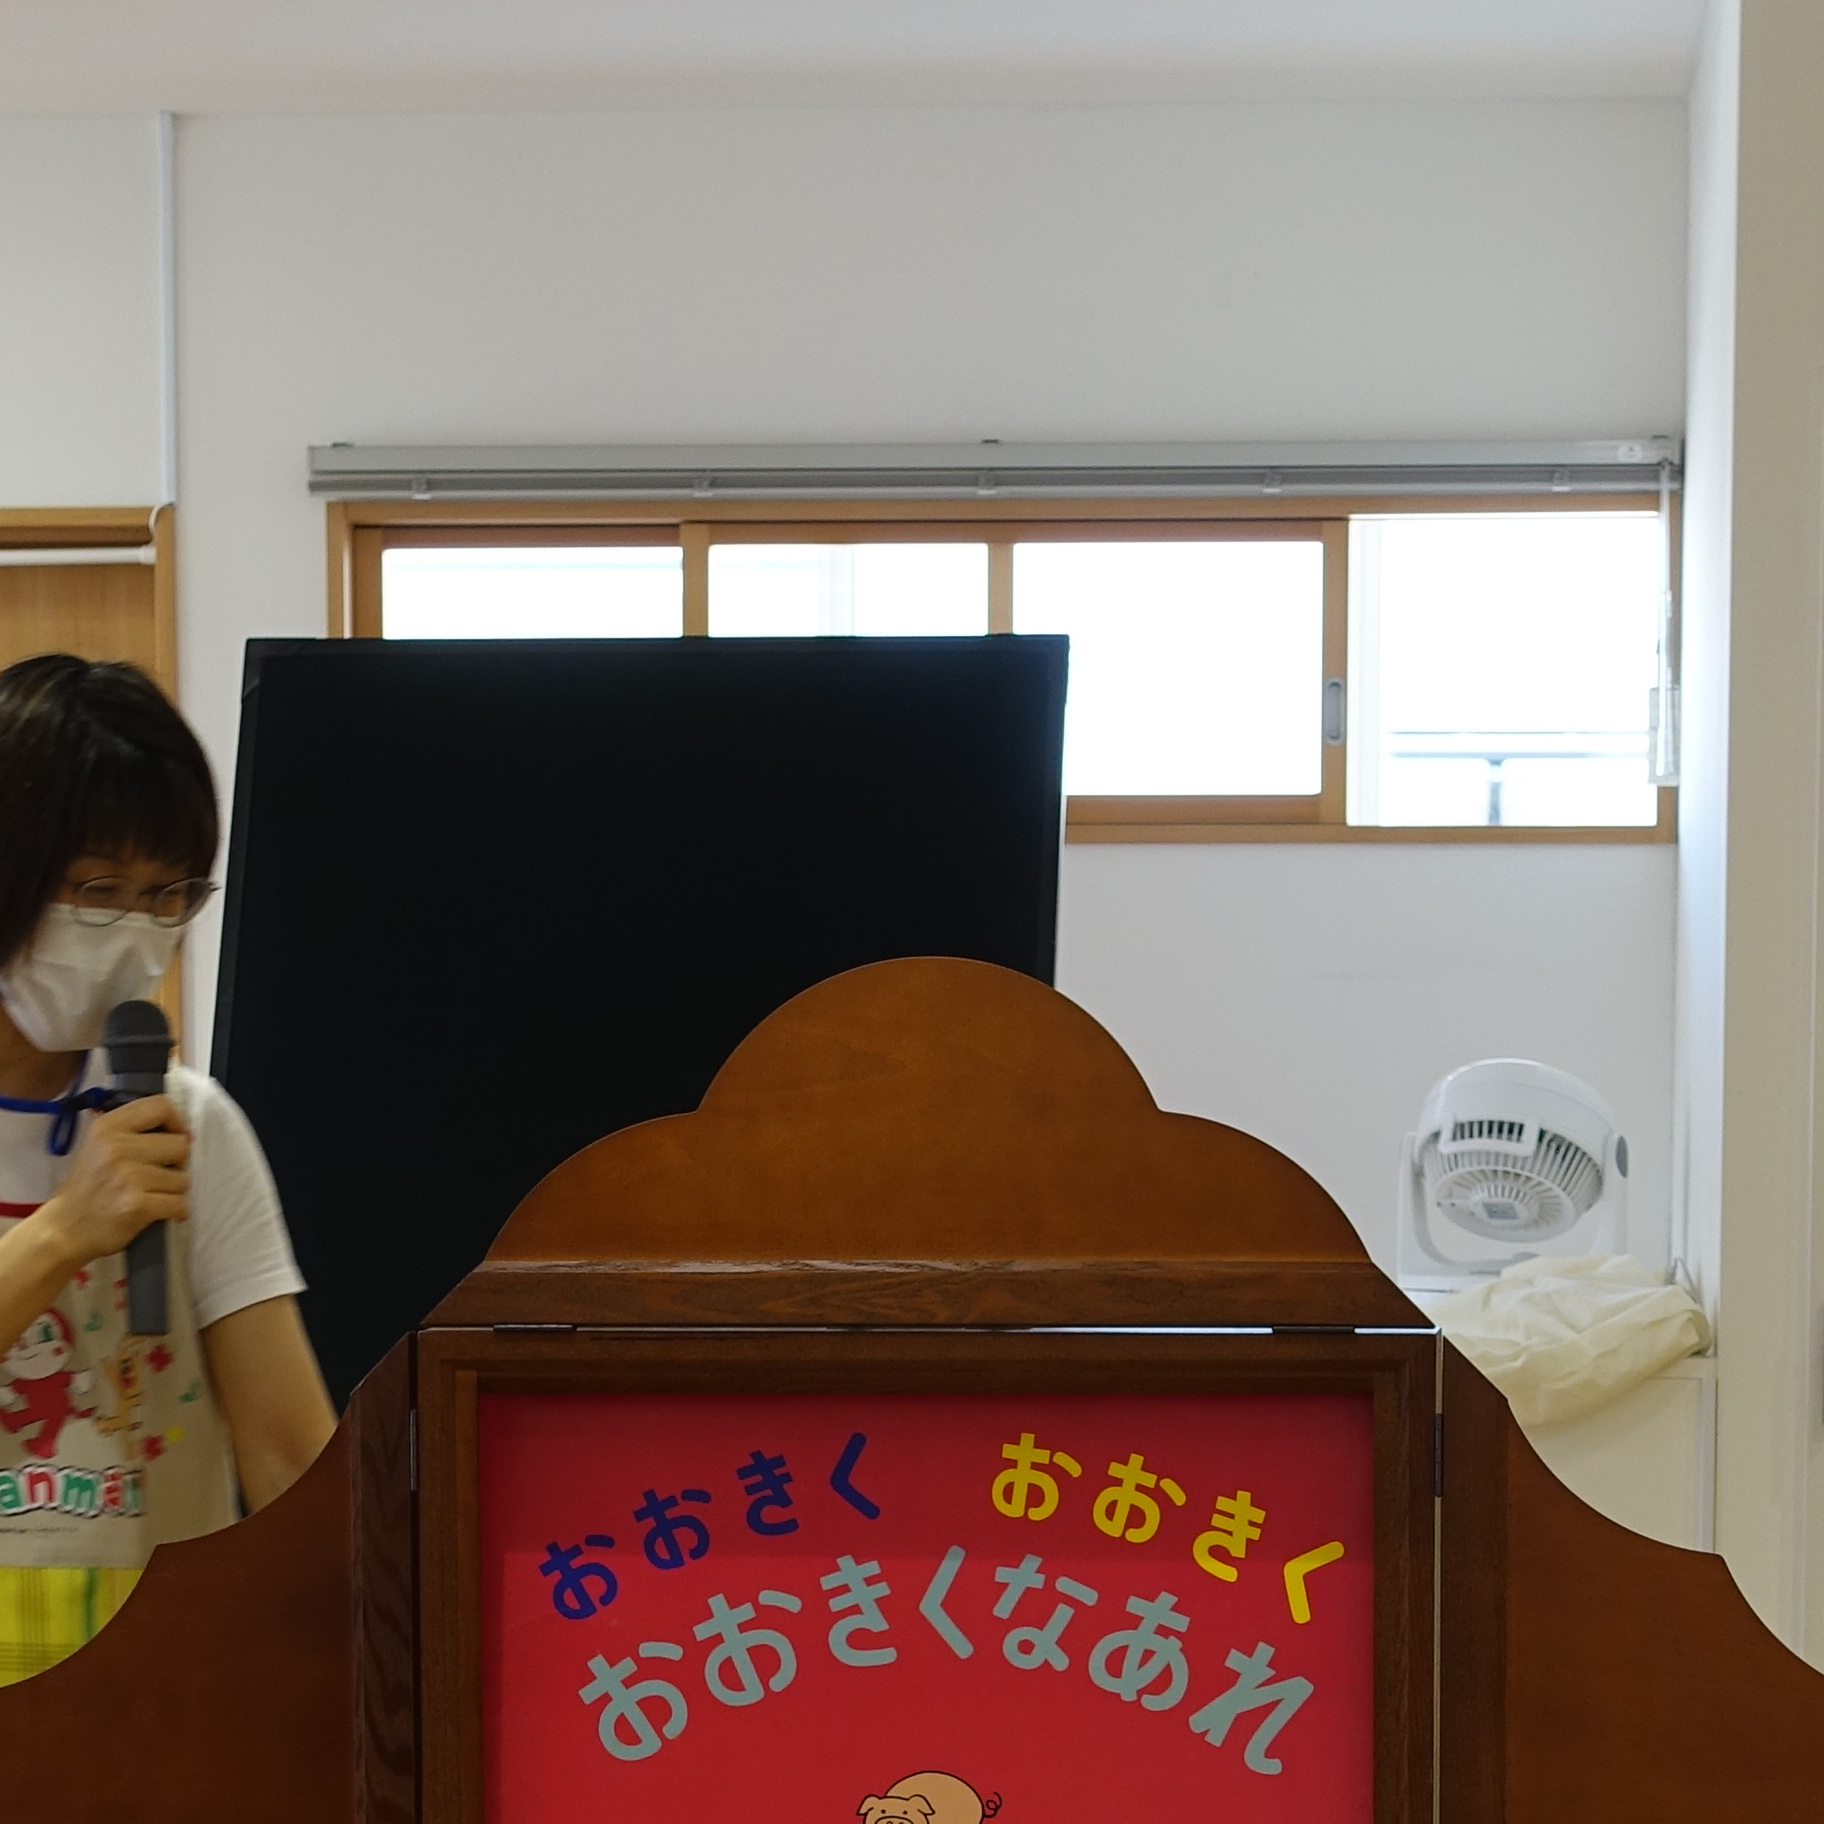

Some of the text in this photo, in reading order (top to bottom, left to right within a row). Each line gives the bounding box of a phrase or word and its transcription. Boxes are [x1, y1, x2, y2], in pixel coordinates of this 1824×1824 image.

[538, 1431, 1346, 1625] おおきく おおきく
[577, 1545, 1315, 1776] おおきくなあれ
